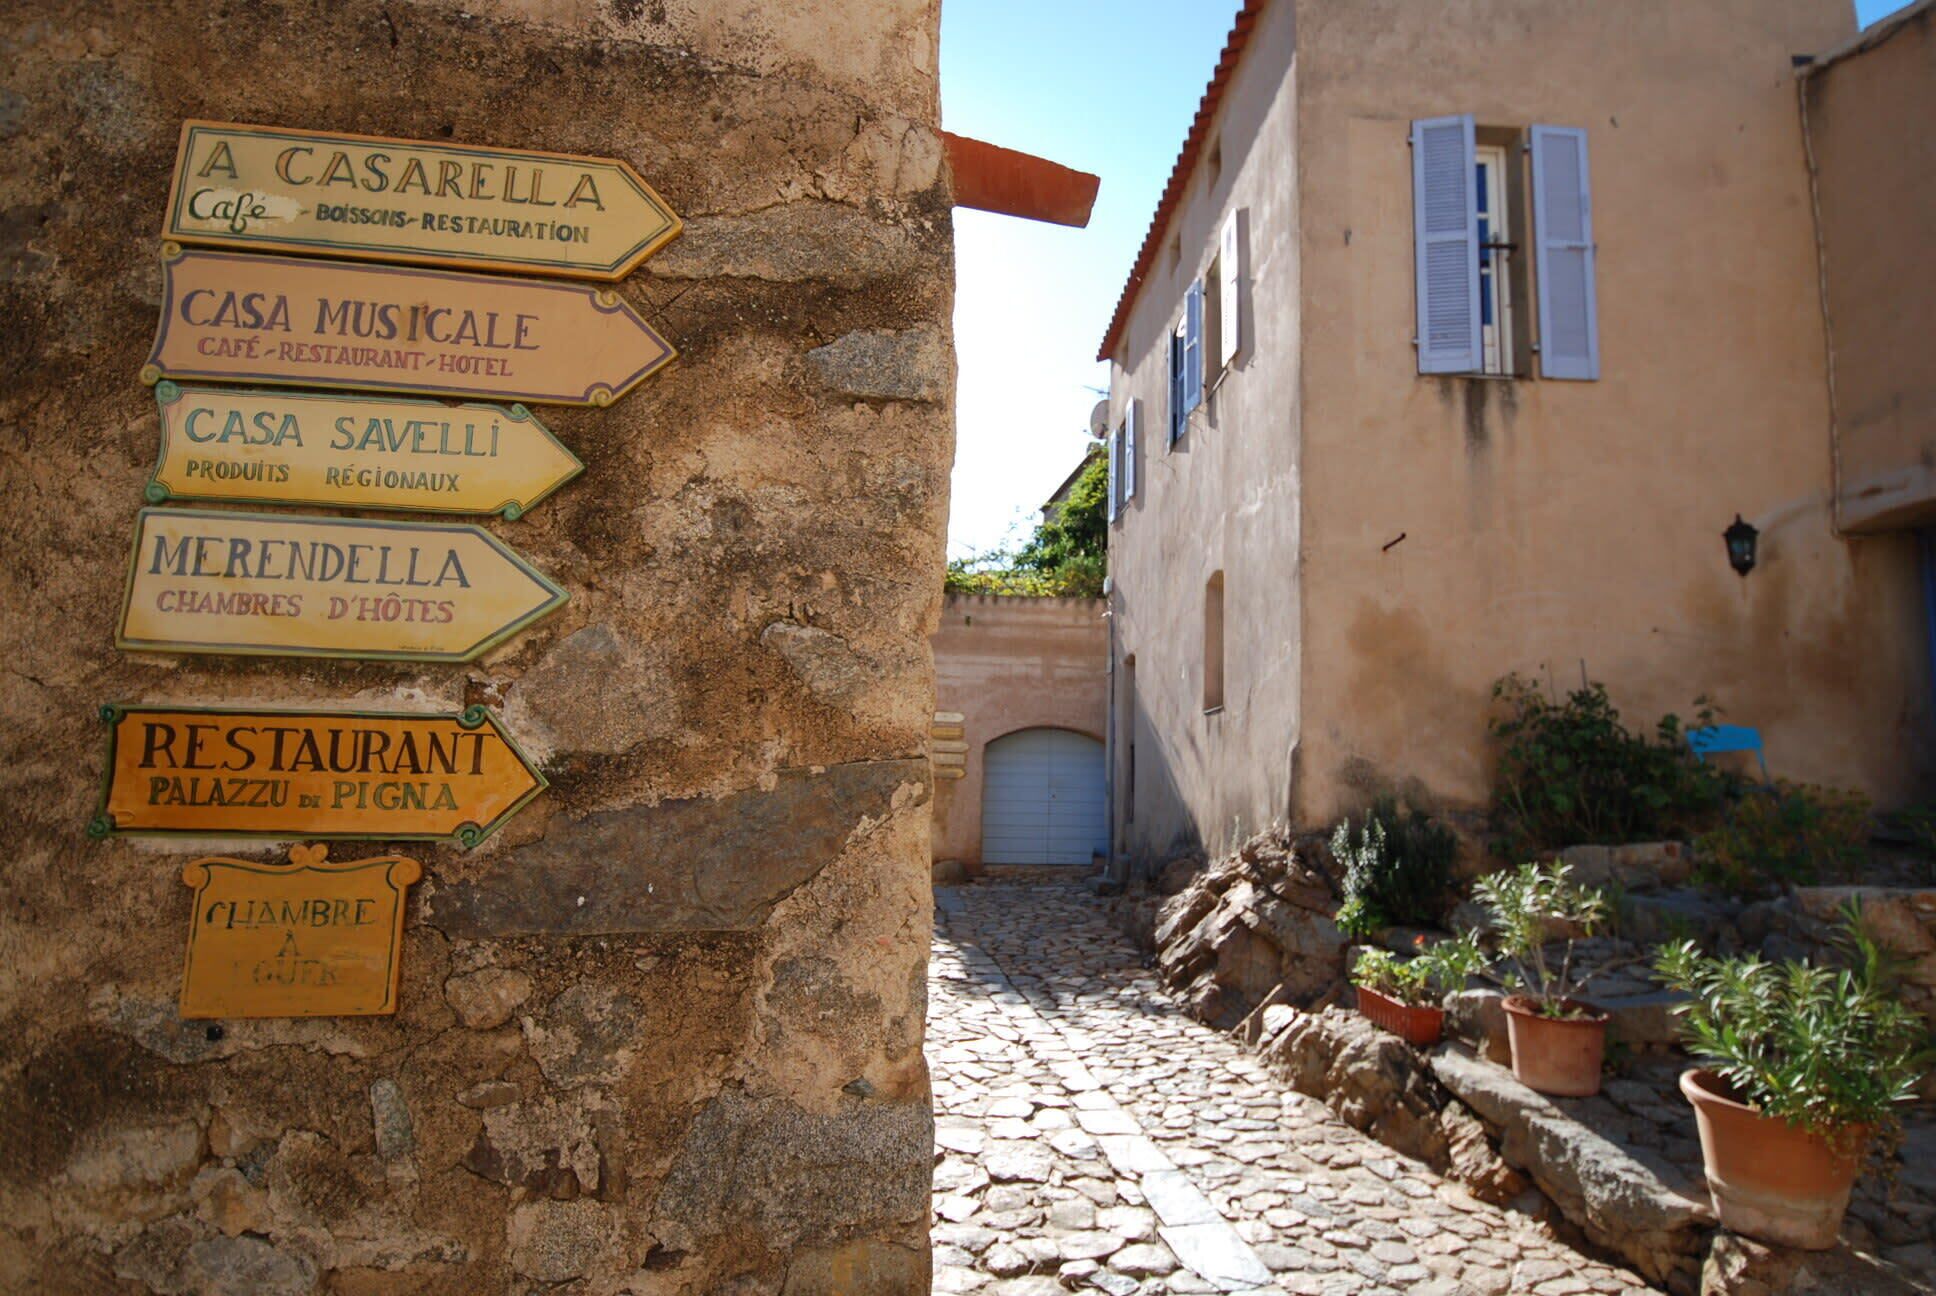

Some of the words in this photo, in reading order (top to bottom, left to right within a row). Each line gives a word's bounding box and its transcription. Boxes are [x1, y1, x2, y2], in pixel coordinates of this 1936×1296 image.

[196, 140, 239, 180] A
[274, 146, 606, 212] CASARELLA
[187, 187, 284, 234] Café
[180, 288, 293, 332] CASA
[314, 297, 541, 351] MUSICALE
[184, 407, 304, 448] CASA
[148, 535, 471, 589] MERENDELLA
[156, 589, 304, 618] CHAMBRES
[327, 591, 456, 624] D'HÔTES
[137, 722, 496, 776] RESTAURANT
[147, 775, 291, 808] PALAZZU
[298, 793, 321, 809] DI
[330, 780, 460, 812] PIGNA
[205, 898, 377, 930] CHAMBRE
